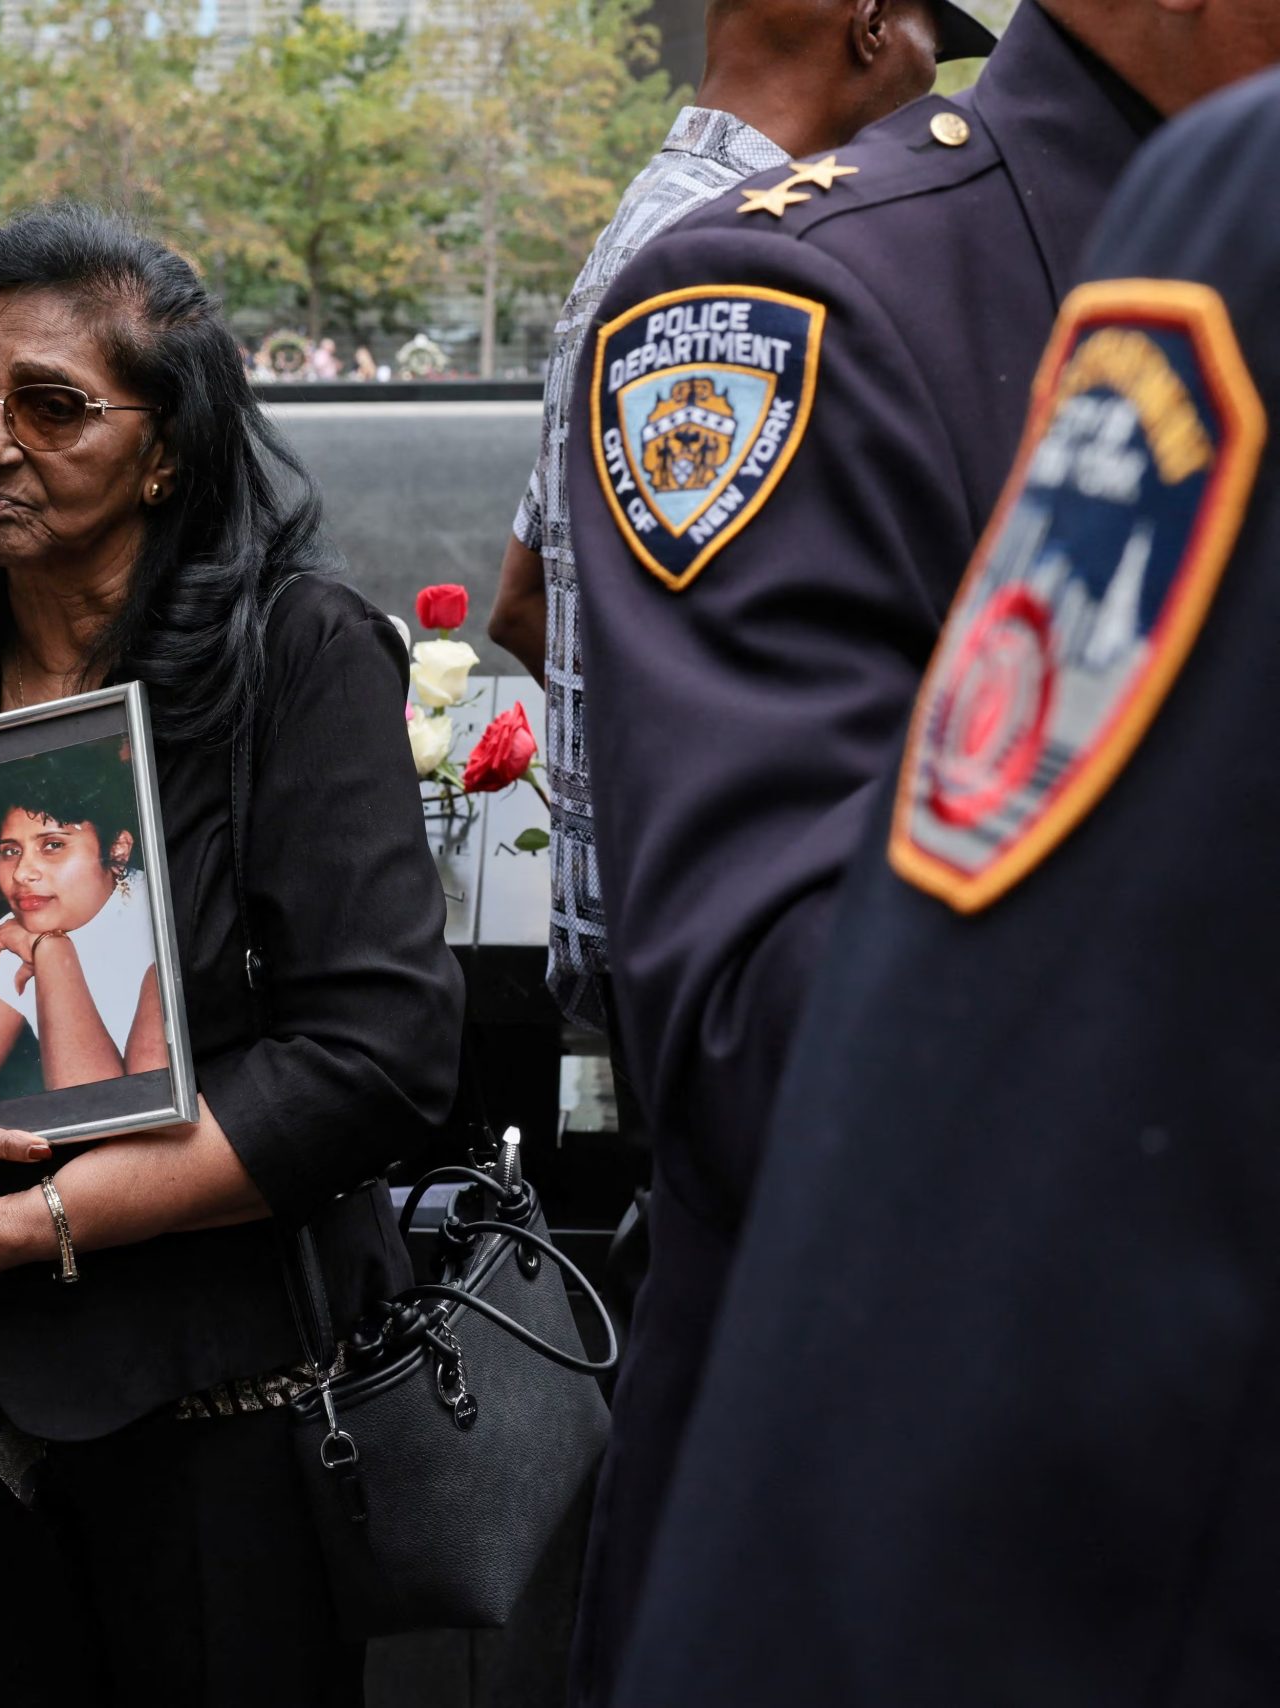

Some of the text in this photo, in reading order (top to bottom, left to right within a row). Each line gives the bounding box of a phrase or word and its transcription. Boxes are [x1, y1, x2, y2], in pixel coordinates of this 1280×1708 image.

[645, 301, 752, 343] POLICE
[608, 332, 792, 392] DEPARTMENT
[603, 397, 794, 544] CITY OF NEW YORK
